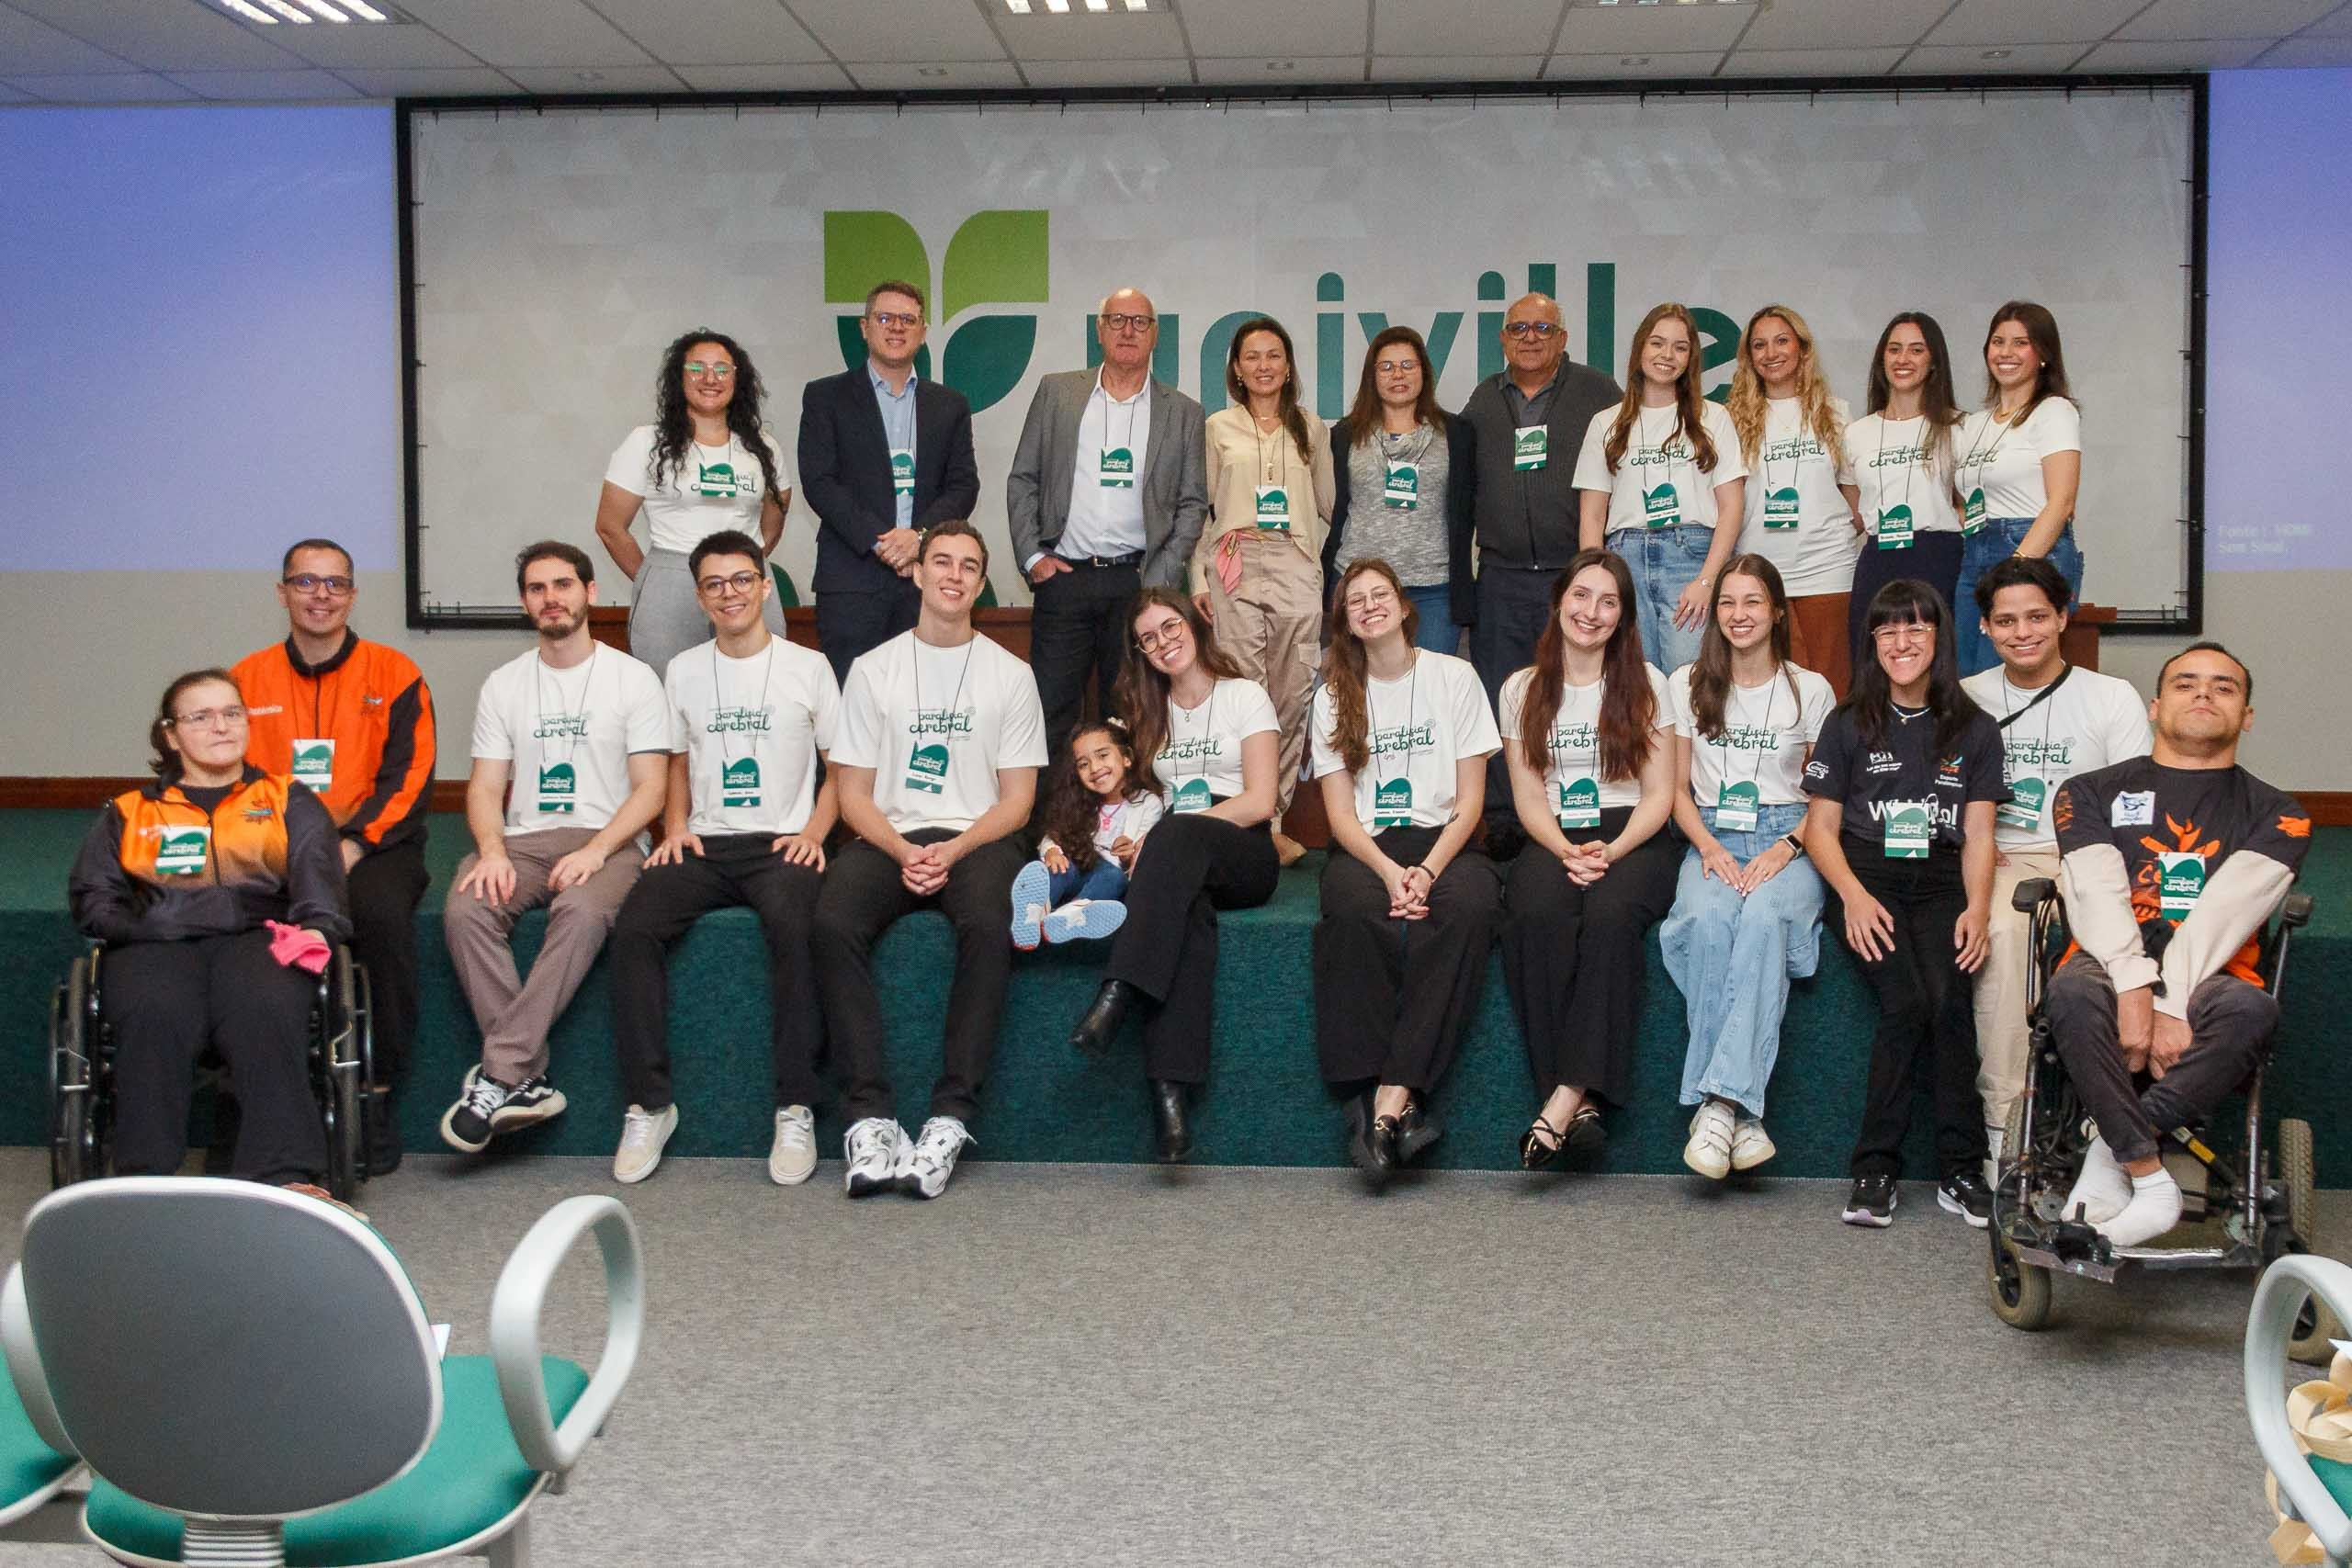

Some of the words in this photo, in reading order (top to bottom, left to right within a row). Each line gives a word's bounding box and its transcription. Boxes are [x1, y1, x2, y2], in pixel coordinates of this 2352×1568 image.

[1087, 263, 1743, 420] nivile
[1764, 444, 1825, 462] cerebral
[707, 714, 772, 732] cerebral
[910, 715, 972, 733] cerebral
[1557, 722, 1600, 736] paralis
[1726, 724, 1770, 739] aralisia
[1157, 739, 1221, 760] cerebral
[1170, 738, 1213, 748] aralisia
[1368, 728, 1434, 754] cerebral
[1546, 735, 1600, 749] cerebr
[2005, 747, 2072, 764] erebral
